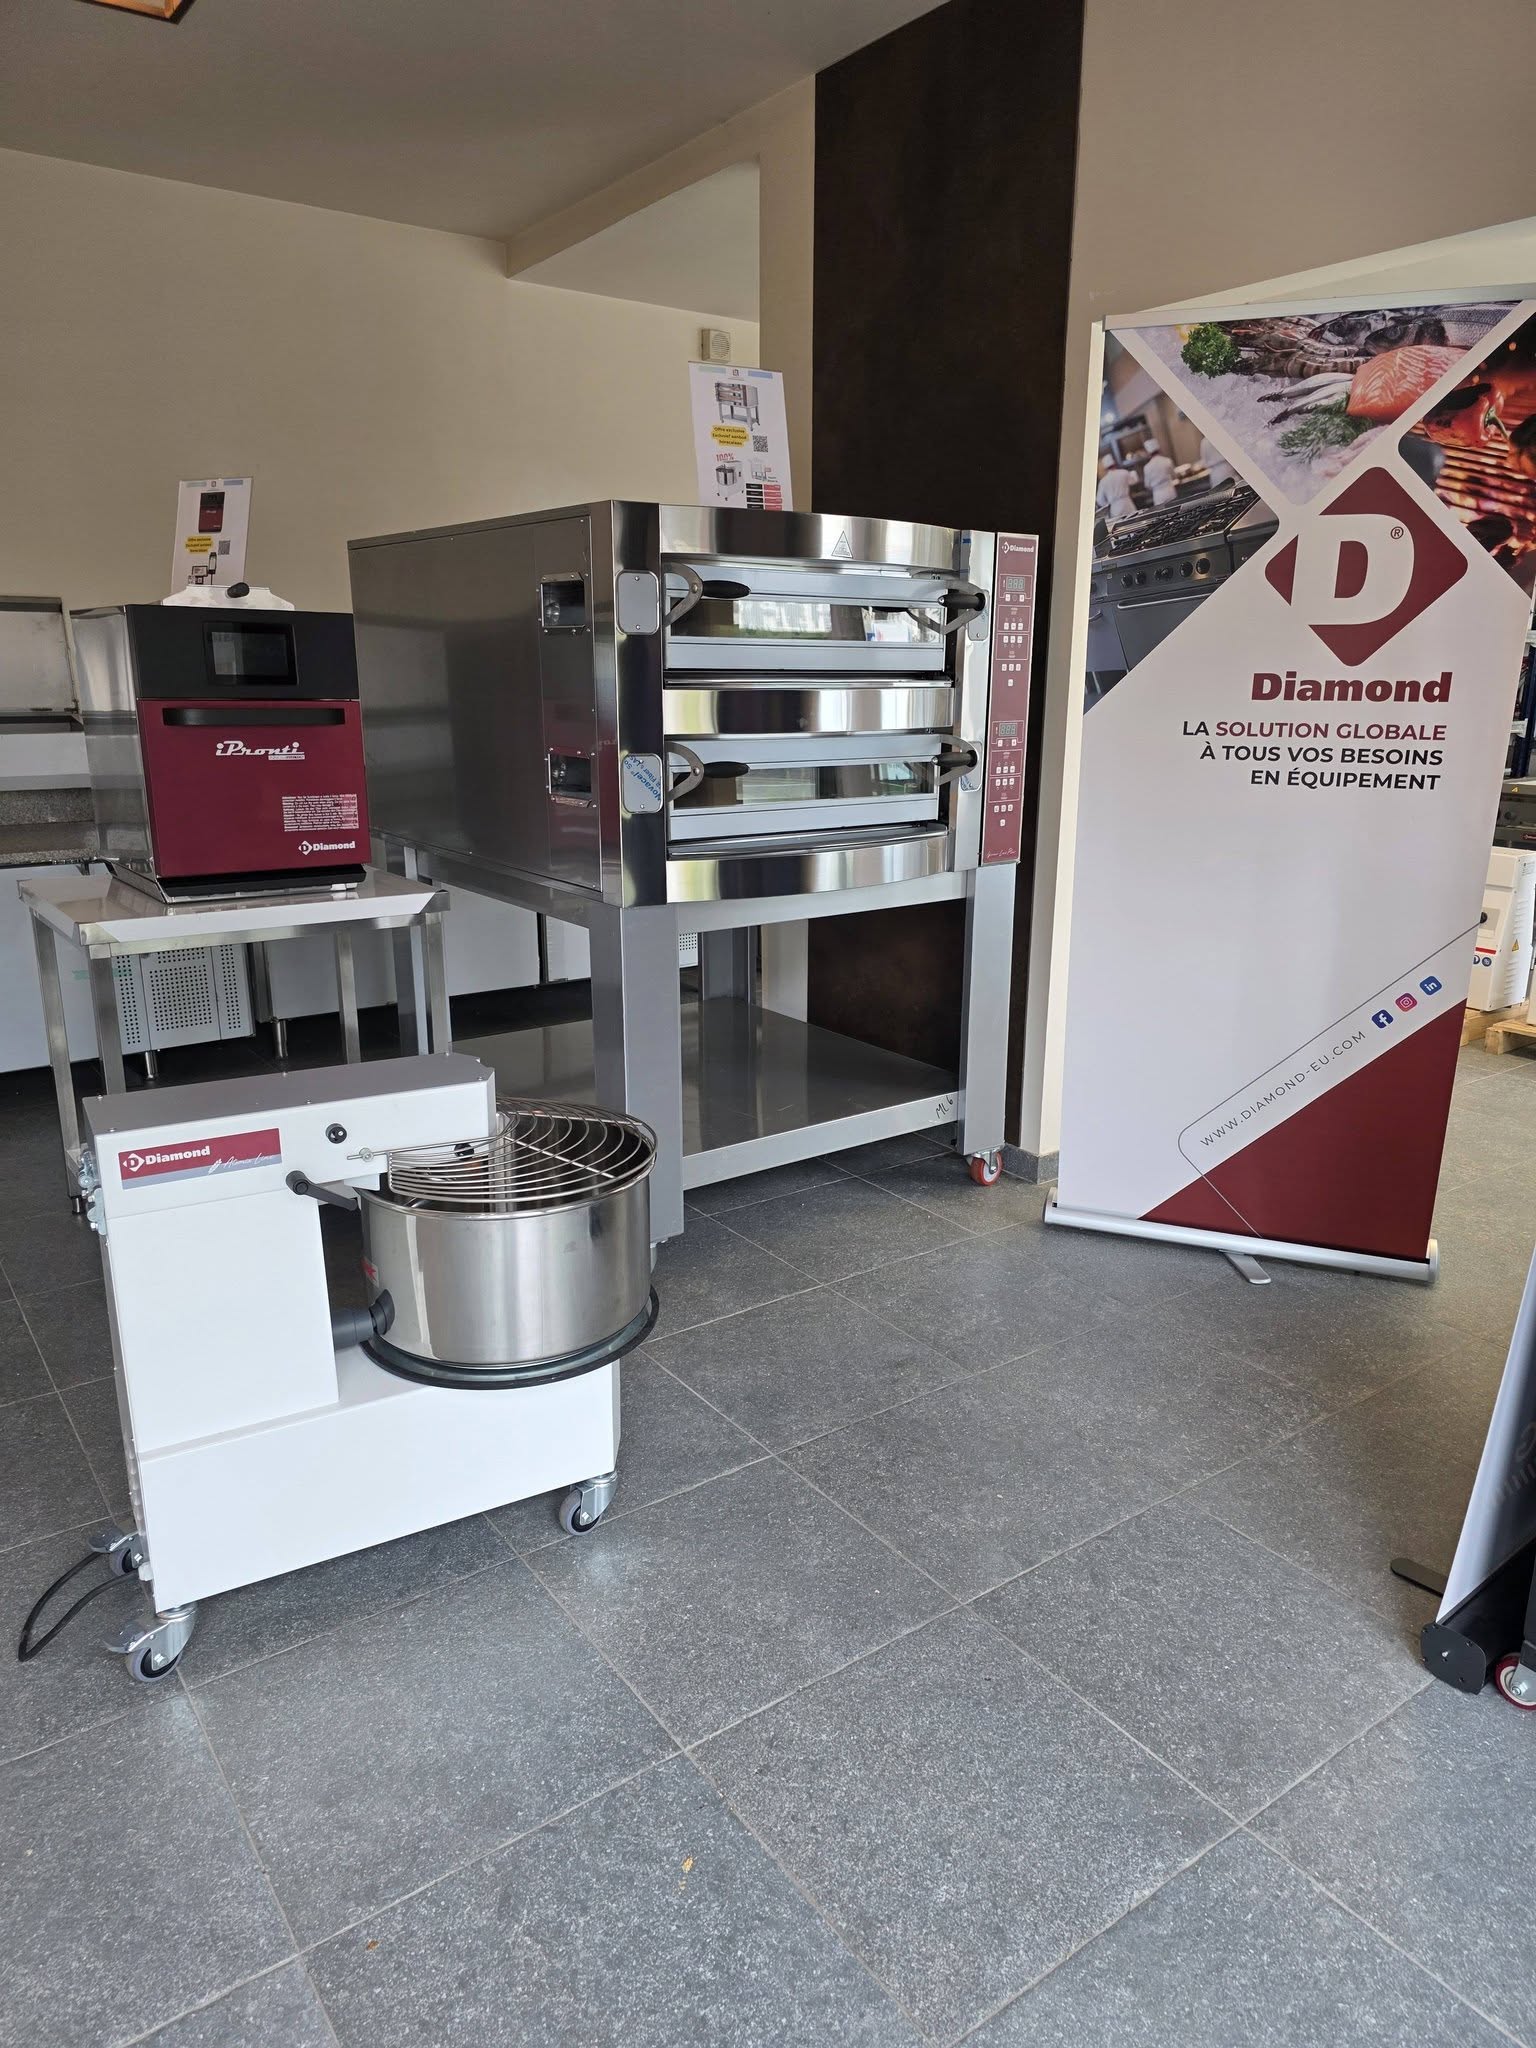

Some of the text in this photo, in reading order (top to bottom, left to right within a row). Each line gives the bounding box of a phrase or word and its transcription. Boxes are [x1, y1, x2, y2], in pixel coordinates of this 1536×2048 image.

[1009, 544, 1035, 553] Diamond
[1251, 671, 1453, 703] Diamond
[1182, 720, 1447, 741] LA SOLUTION GLOBALE
[216, 740, 305, 756] iPronti
[1199, 741, 1444, 766] À TOUS VOS BESOINS
[1250, 767, 1441, 790] EN ÉQUIPEMENT
[312, 841, 355, 852] Diamond
[1200, 1030, 1366, 1146] WWW.DIAMOND-EU.COM
[144, 1146, 211, 1165] Diamond
